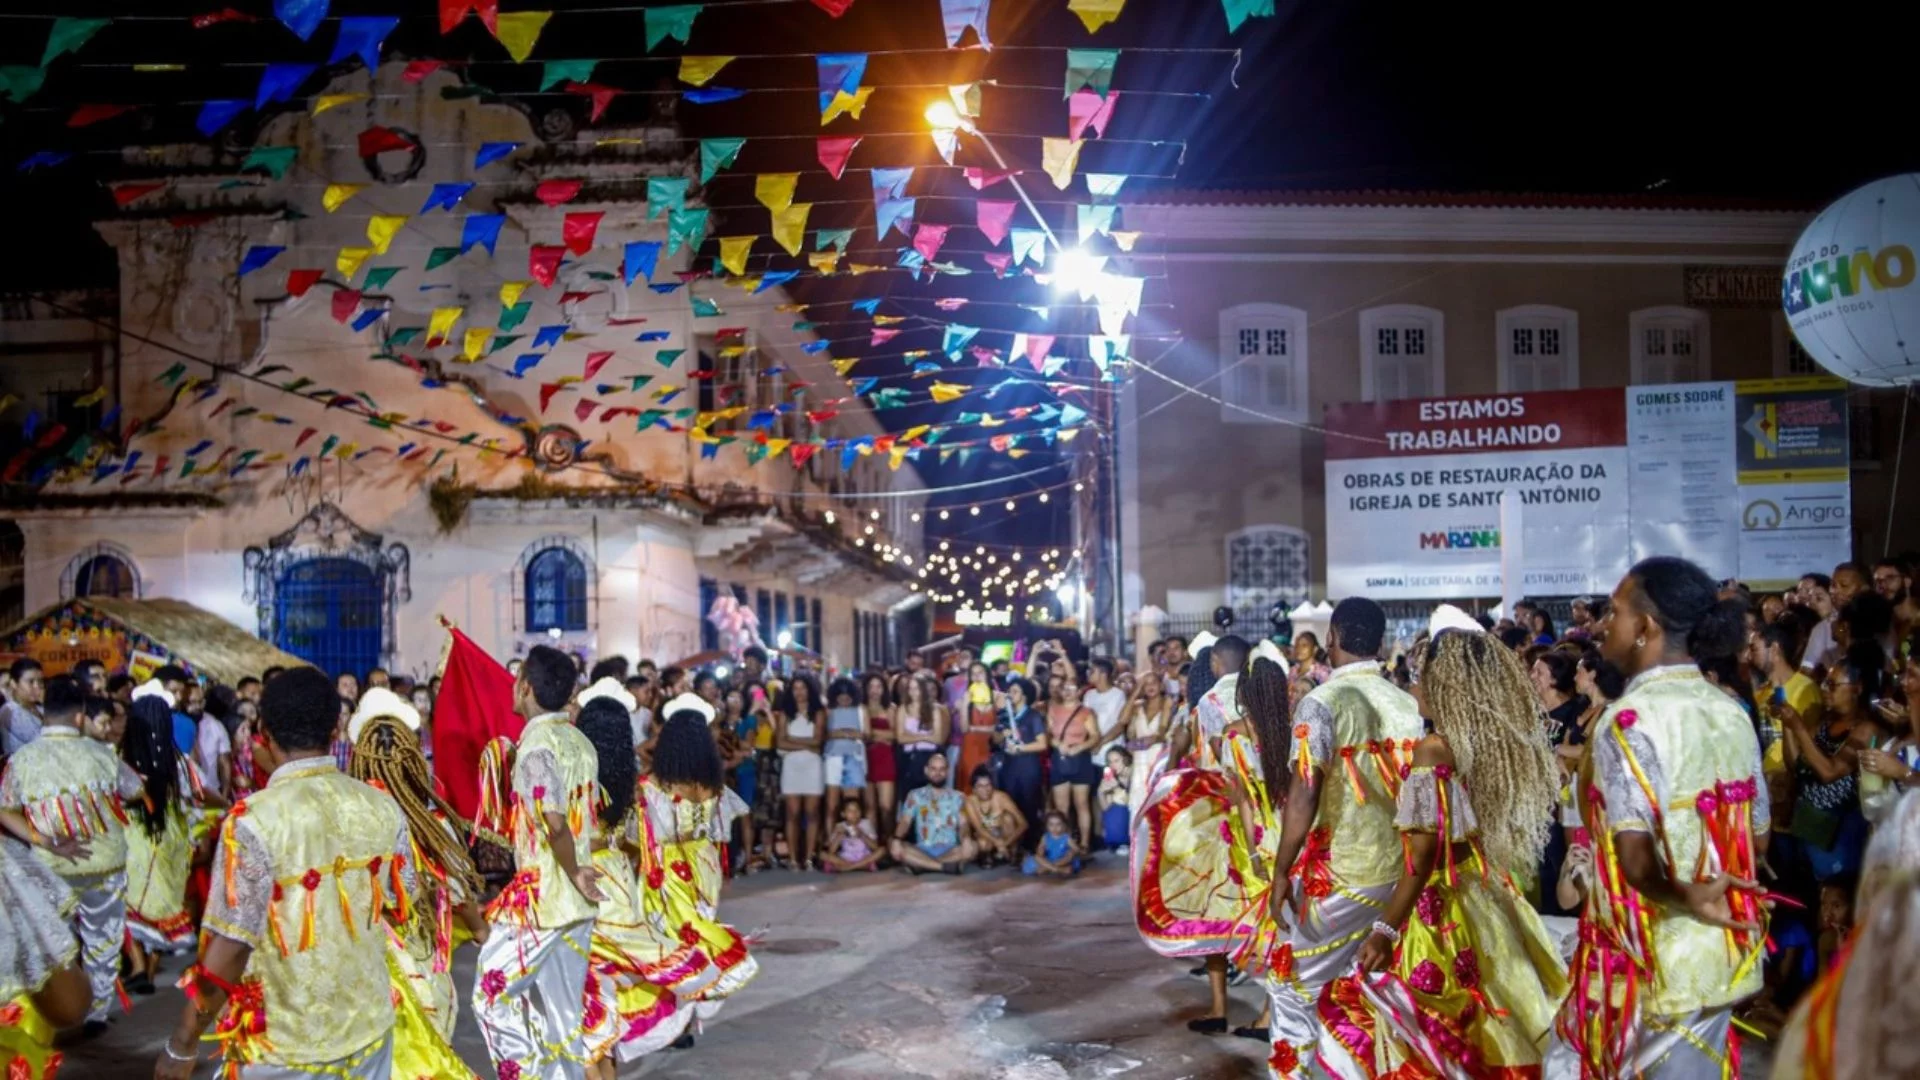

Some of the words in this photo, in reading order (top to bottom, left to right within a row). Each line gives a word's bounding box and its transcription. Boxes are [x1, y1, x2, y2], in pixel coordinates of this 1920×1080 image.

[1820, 244, 1839, 258] DO
[1837, 302, 1874, 314] TODOS
[1636, 392, 1681, 406] GOMES
[1684, 387, 1725, 403] SODRÉ
[1419, 397, 1524, 421] ESTAMOS
[1386, 424, 1561, 450] TRABALHANDO
[1343, 472, 1405, 489] OBRAS
[1411, 470, 1434, 486] DE
[1440, 461, 1574, 485] RESTAURAÇÃO
[1580, 463, 1606, 479] DA
[1350, 494, 1412, 512] IGREJA
[1418, 493, 1441, 508] DE
[1785, 504, 1845, 522] Angra
[1420, 531, 1501, 549] MARANH
[1366, 577, 1403, 588] SINFRA
[1409, 575, 1472, 587] SECRETARIA
[1475, 575, 1488, 585] DE
